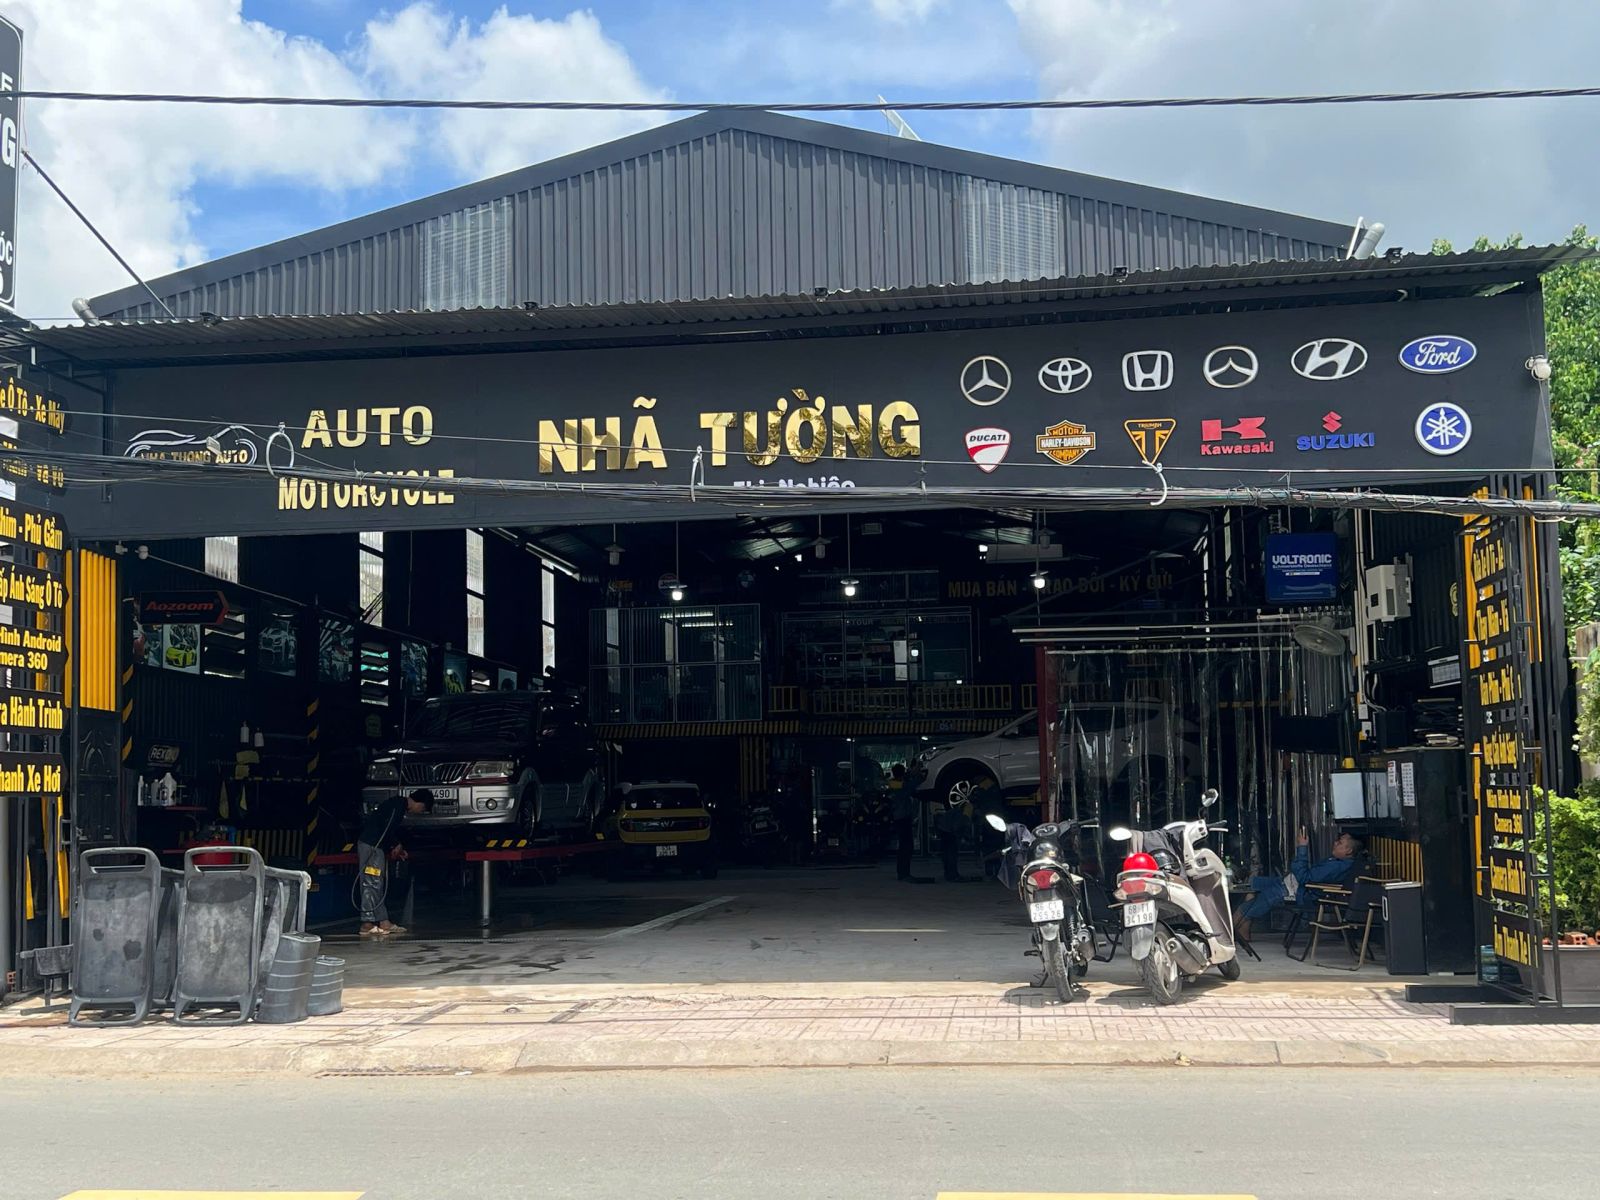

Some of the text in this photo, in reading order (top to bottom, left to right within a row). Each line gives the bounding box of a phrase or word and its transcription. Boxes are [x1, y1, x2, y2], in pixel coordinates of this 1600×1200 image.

[1415, 341, 1460, 366] Ford
[36, 395, 46, 423] Xe
[48, 400, 65, 434] Máy
[301, 405, 433, 449] AUTO
[539, 389, 920, 473] NHÃ TƯỜNG
[969, 434, 1006, 442] DUCATI
[1297, 433, 1375, 450] SUZUKI
[1201, 441, 1274, 456] Kawasaki
[278, 469, 454, 510] MOTORCYCLE
[25, 513, 41, 545] Phủ
[44, 517, 62, 550] Gầm
[1272, 554, 1332, 565] VOLTRONIC
[10, 565, 24, 601] Ánh
[26, 575, 44, 610] Sáng
[46, 573, 52, 606] Ô
[53, 581, 62, 608] Tô
[949, 581, 981, 599] MUA
[23, 630, 61, 652] Android
[28, 651, 48, 670] 360
[10, 696, 35, 727] Hành
[38, 699, 62, 729] Trình
[27, 765, 41, 792] Xe
[44, 765, 61, 792] Hơi
